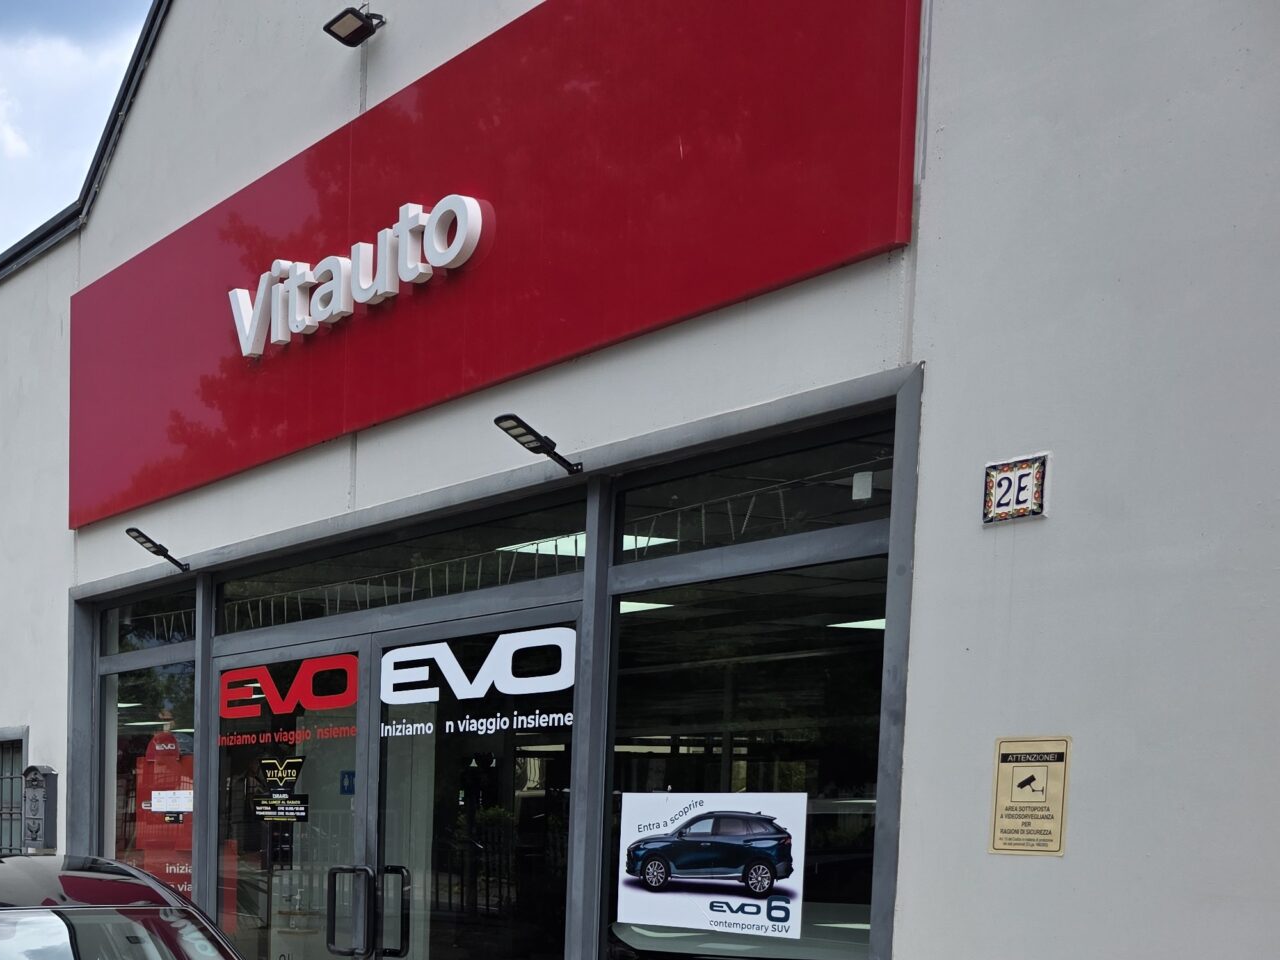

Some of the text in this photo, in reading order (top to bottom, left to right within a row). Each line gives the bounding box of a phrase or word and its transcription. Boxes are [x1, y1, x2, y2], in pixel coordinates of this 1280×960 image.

[229, 194, 482, 357] Vitauto
[996, 472, 1031, 508] 2E
[380, 627, 577, 705] EVO
[219, 654, 359, 719] EVO
[259, 732, 272, 744] un
[274, 727, 312, 745] viaggio
[314, 723, 358, 739] nsieme
[380, 719, 434, 738] Iniziamo
[457, 712, 510, 735] viaggio
[513, 709, 574, 729] insieme
[266, 769, 297, 778] VITAUTO
[637, 799, 705, 833] Entra a scoprire
[709, 895, 791, 923] EVO 6
[709, 919, 791, 933] contemporary SUV
